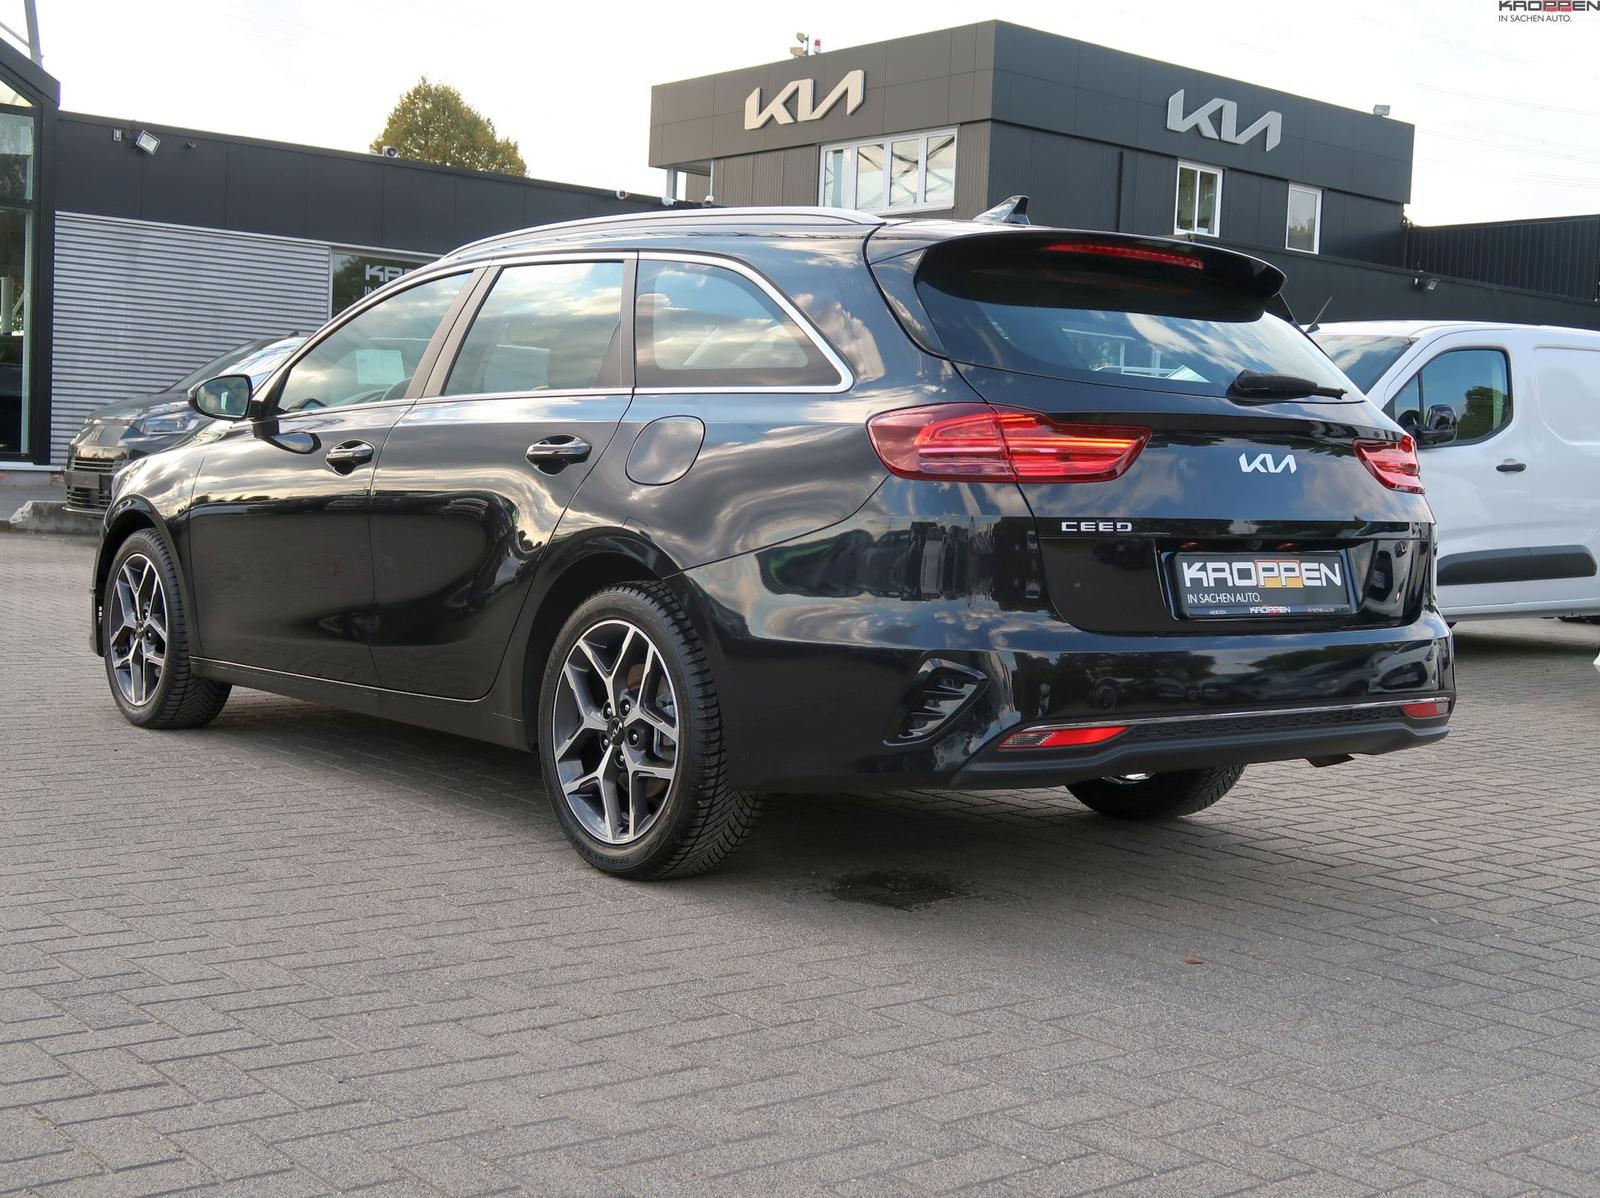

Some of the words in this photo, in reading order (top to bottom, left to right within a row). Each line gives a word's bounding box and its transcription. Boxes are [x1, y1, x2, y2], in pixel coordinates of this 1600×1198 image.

[744, 69, 865, 130] KIA
[1166, 88, 1283, 152] KIA
[1238, 453, 1297, 474] KIA
[1061, 521, 1133, 532] CEED
[1182, 561, 1342, 587] KROPPEN
[1187, 594, 1198, 604] IN
[1199, 593, 1236, 604] SACHEN
[1236, 592, 1263, 603] AUTO.
[1249, 606, 1291, 614] KROPPEN
